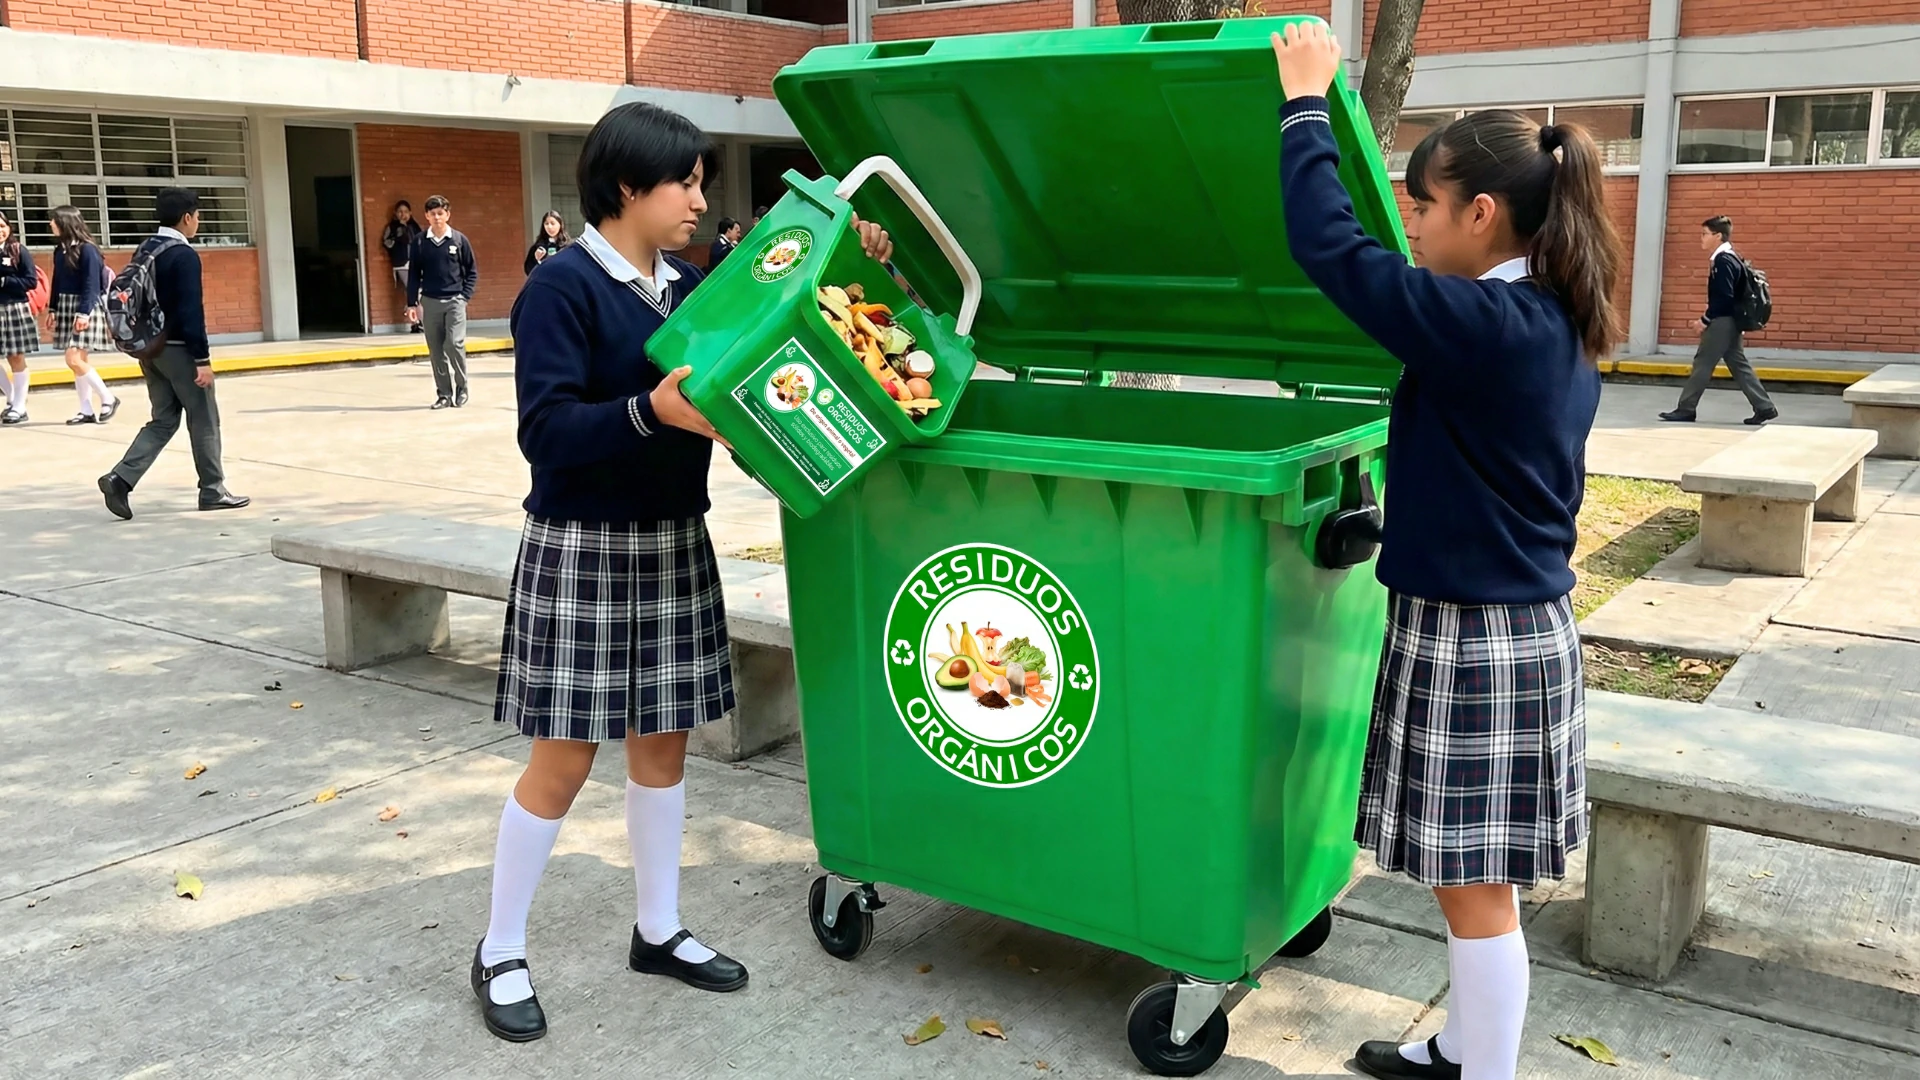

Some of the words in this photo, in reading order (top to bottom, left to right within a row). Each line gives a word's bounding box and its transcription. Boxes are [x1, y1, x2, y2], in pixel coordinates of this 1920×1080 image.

[771, 231, 810, 248] RESIDUOS
[815, 414, 827, 427] origen
[826, 426, 840, 440] animal
[840, 442, 855, 457] vegetal
[827, 405, 862, 443] ORGÁNICOS
[836, 401, 867, 435] RESIDUOS
[793, 414, 802, 424] Uso
[800, 423, 818, 442] exclusivo
[816, 441, 827, 452] para
[825, 450, 842, 468] residuos
[908, 552, 1081, 636] RESIDUOS
[906, 697, 1078, 782] ORGÁNICOS
